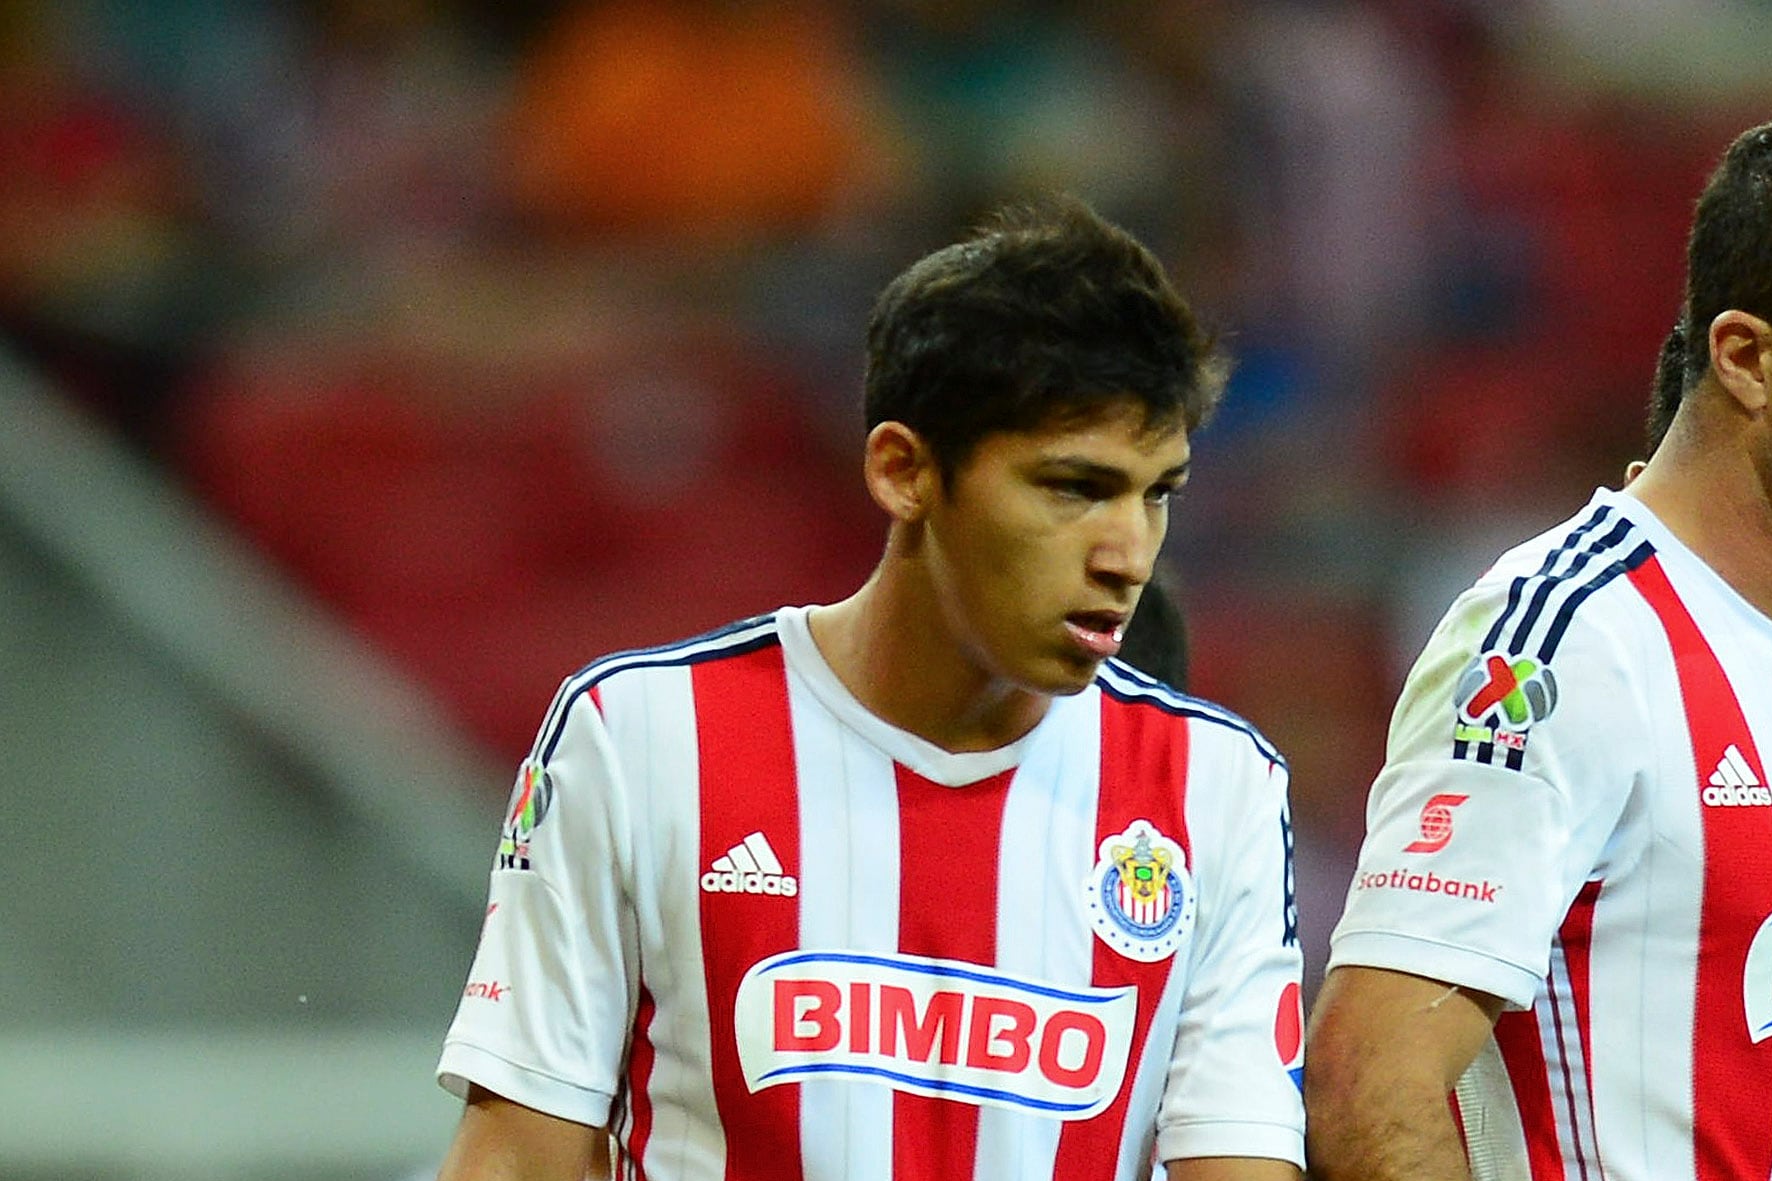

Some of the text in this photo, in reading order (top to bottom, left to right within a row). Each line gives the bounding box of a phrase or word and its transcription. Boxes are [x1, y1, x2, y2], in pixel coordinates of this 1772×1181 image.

[1702, 785, 1772, 807] adidas
[701, 868, 798, 897] adidas
[774, 979, 1106, 1089] BIMBO
